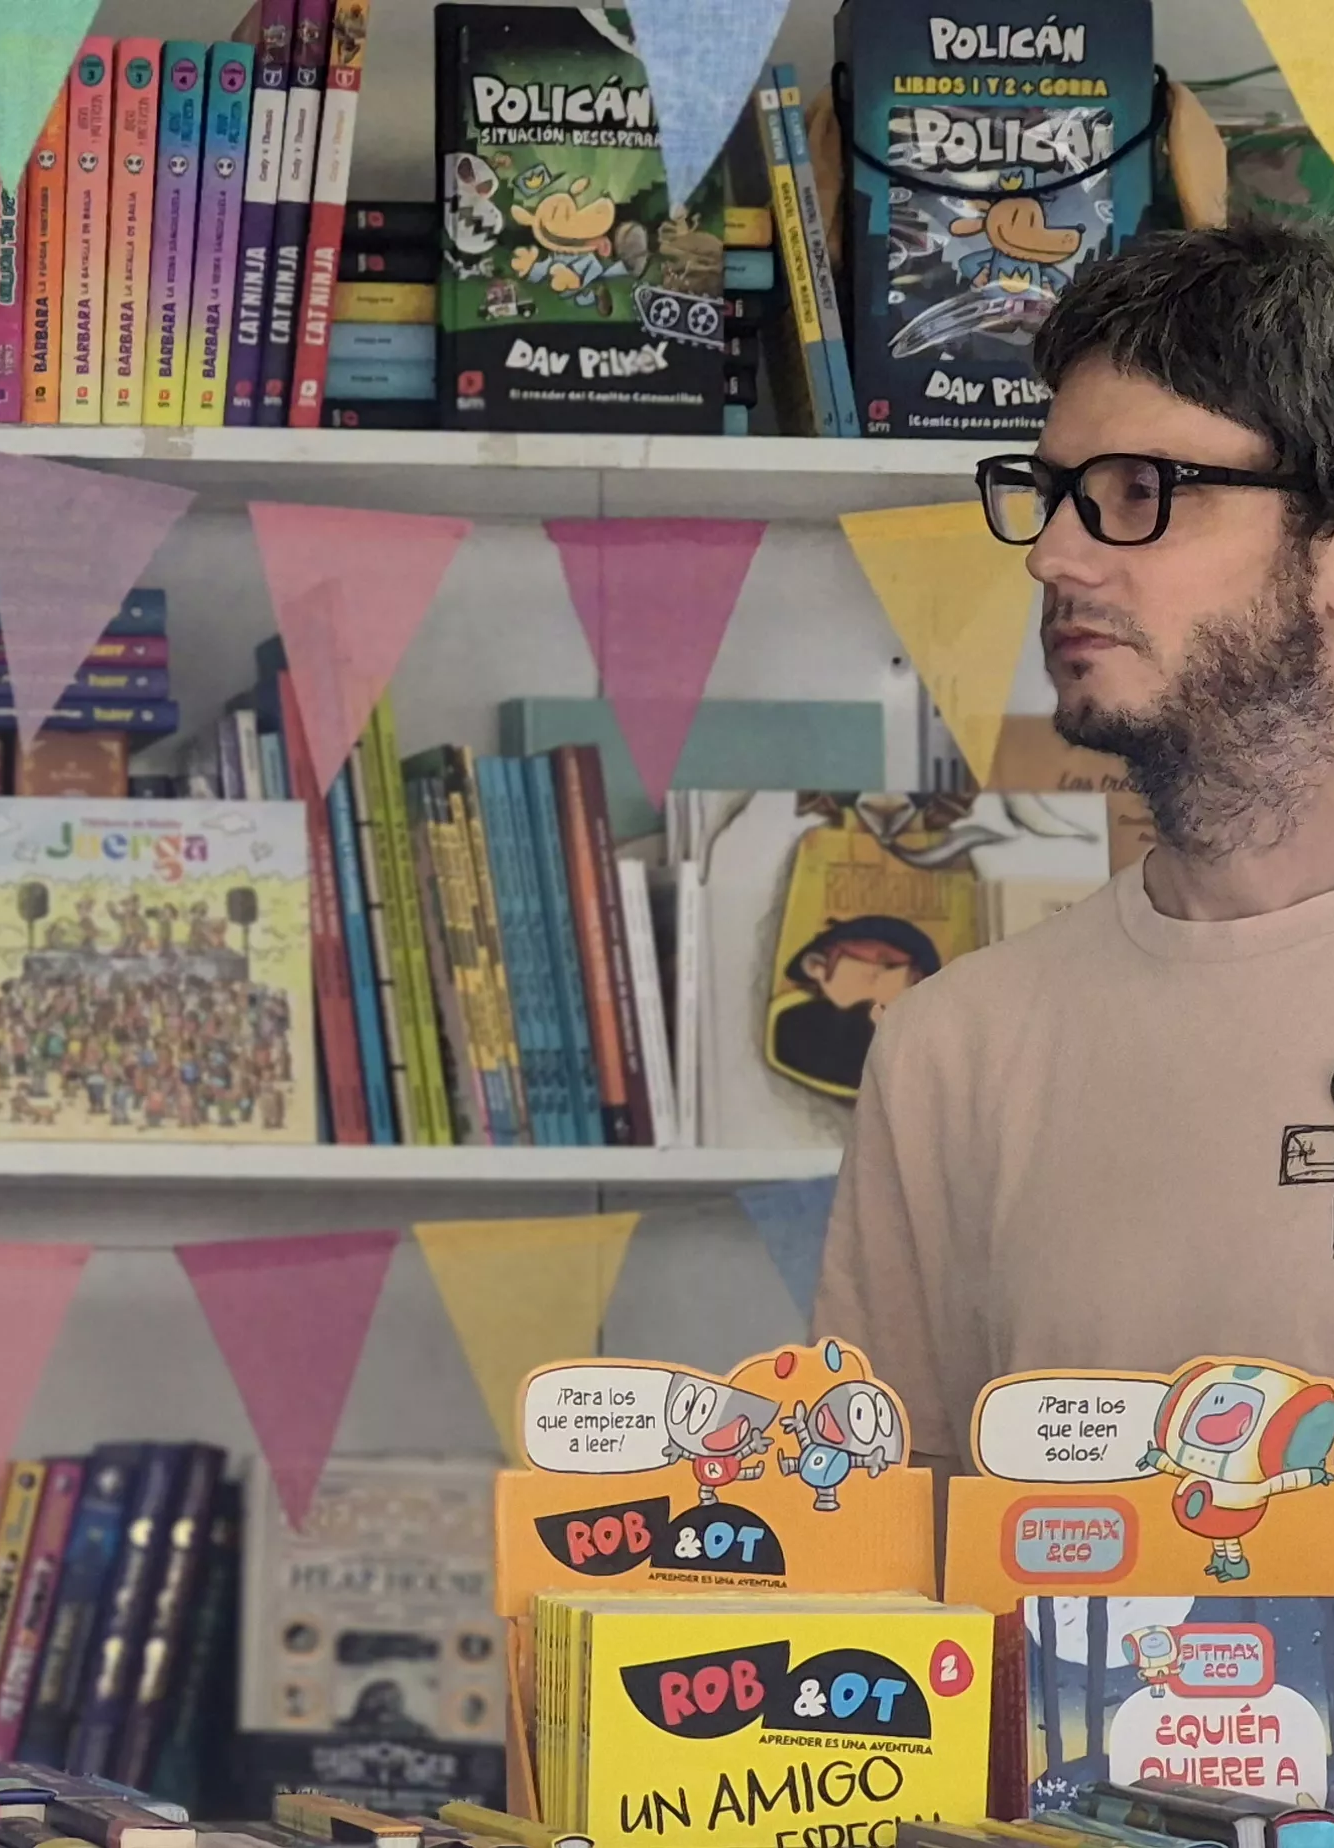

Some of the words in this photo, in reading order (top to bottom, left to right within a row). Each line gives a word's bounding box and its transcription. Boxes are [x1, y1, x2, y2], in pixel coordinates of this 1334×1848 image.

[930, 15, 1085, 62] POLICÁN
[473, 75, 651, 128] POLICÁN
[894, 77, 965, 94] LIBROS
[987, 78, 999, 95] Y
[1005, 79, 1017, 95] 2
[481, 126, 564, 144] SITUACIÓN
[573, 130, 664, 147] DESESPERRA
[242, 247, 266, 304] NINJA
[274, 246, 298, 304] NINJA
[309, 247, 335, 305] NINJA
[76, 298, 91, 374] BÁRBARA
[118, 301, 134, 377] BÁRBARA
[238, 306, 262, 345] CAT
[270, 306, 292, 344] CAT
[304, 307, 327, 345] CAT
[505, 339, 569, 376] DAV
[925, 370, 985, 405] DAV
[45, 821, 209, 884] Juerga
[556, 1387, 603, 1408] ¡Para
[608, 1386, 636, 1406] los
[1038, 1395, 1084, 1418] ¡Para
[1090, 1397, 1125, 1417] los
[536, 1413, 569, 1433] que
[573, 1411, 657, 1435] empiezan
[1037, 1421, 1072, 1442] que
[1078, 1418, 1117, 1439] leen
[569, 1441, 579, 1453] a
[584, 1432, 624, 1454] leer!
[1046, 1443, 1108, 1463] solos!
[566, 1511, 652, 1565] ROB
[1022, 1519, 1120, 1542] BITMAX
[940, 1654, 959, 1682] 2
[1181, 1643, 1259, 1661] BITMAX
[659, 1660, 764, 1725] ROB
[1155, 1703, 1280, 1745] ¿QUIÉN
[759, 1734, 822, 1748] APRENDER
[825, 1737, 839, 1749] ES
[841, 1739, 867, 1750] UNA
[870, 1740, 933, 1755] AVENTURA
[1140, 1757, 1265, 1787] QUIERE
[1276, 1757, 1299, 1787] A
[620, 1787, 691, 1835] UN
[708, 1756, 903, 1831] AMIGO
